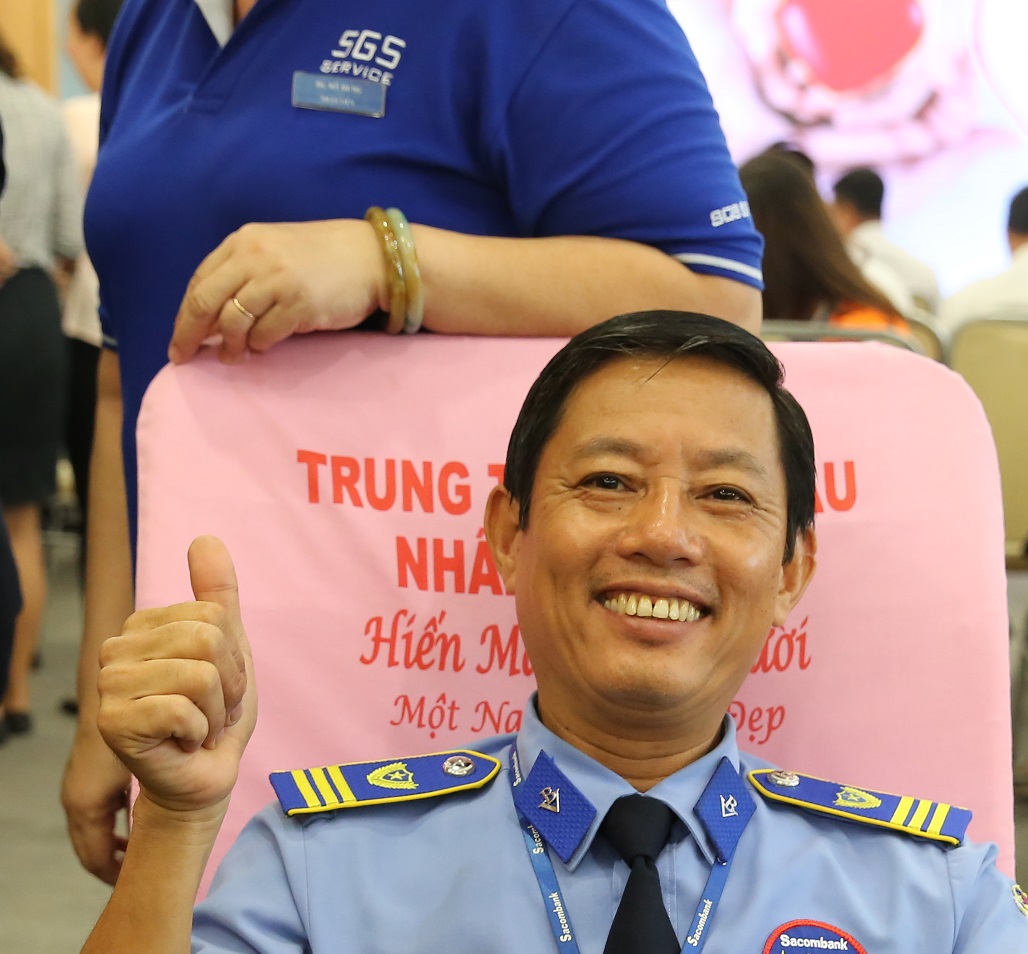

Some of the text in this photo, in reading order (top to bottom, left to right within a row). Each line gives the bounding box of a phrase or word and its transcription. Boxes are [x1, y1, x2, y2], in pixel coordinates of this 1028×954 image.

[331, 29, 407, 70] SGS
[297, 449, 472, 516] TRUNG
[389, 692, 461, 740] Một
[548, 891, 573, 943] Sacombank
[686, 897, 714, 948] Sacombank
[779, 934, 849, 951] Sacombank
